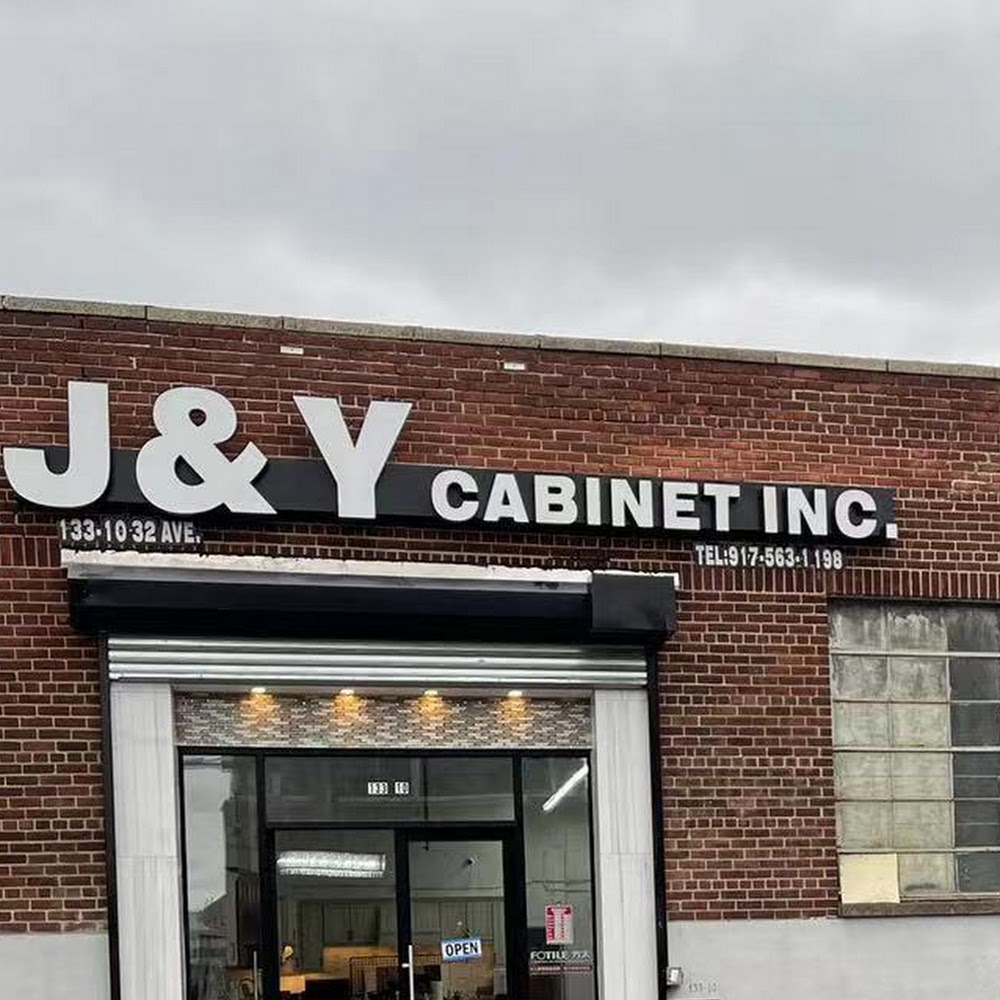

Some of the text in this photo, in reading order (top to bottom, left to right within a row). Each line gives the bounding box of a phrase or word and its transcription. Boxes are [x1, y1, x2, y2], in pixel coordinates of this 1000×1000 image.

[431, 469, 741, 532] CABINET
[762, 485, 898, 540] INC.
[445, 942, 478, 956] OPEN
